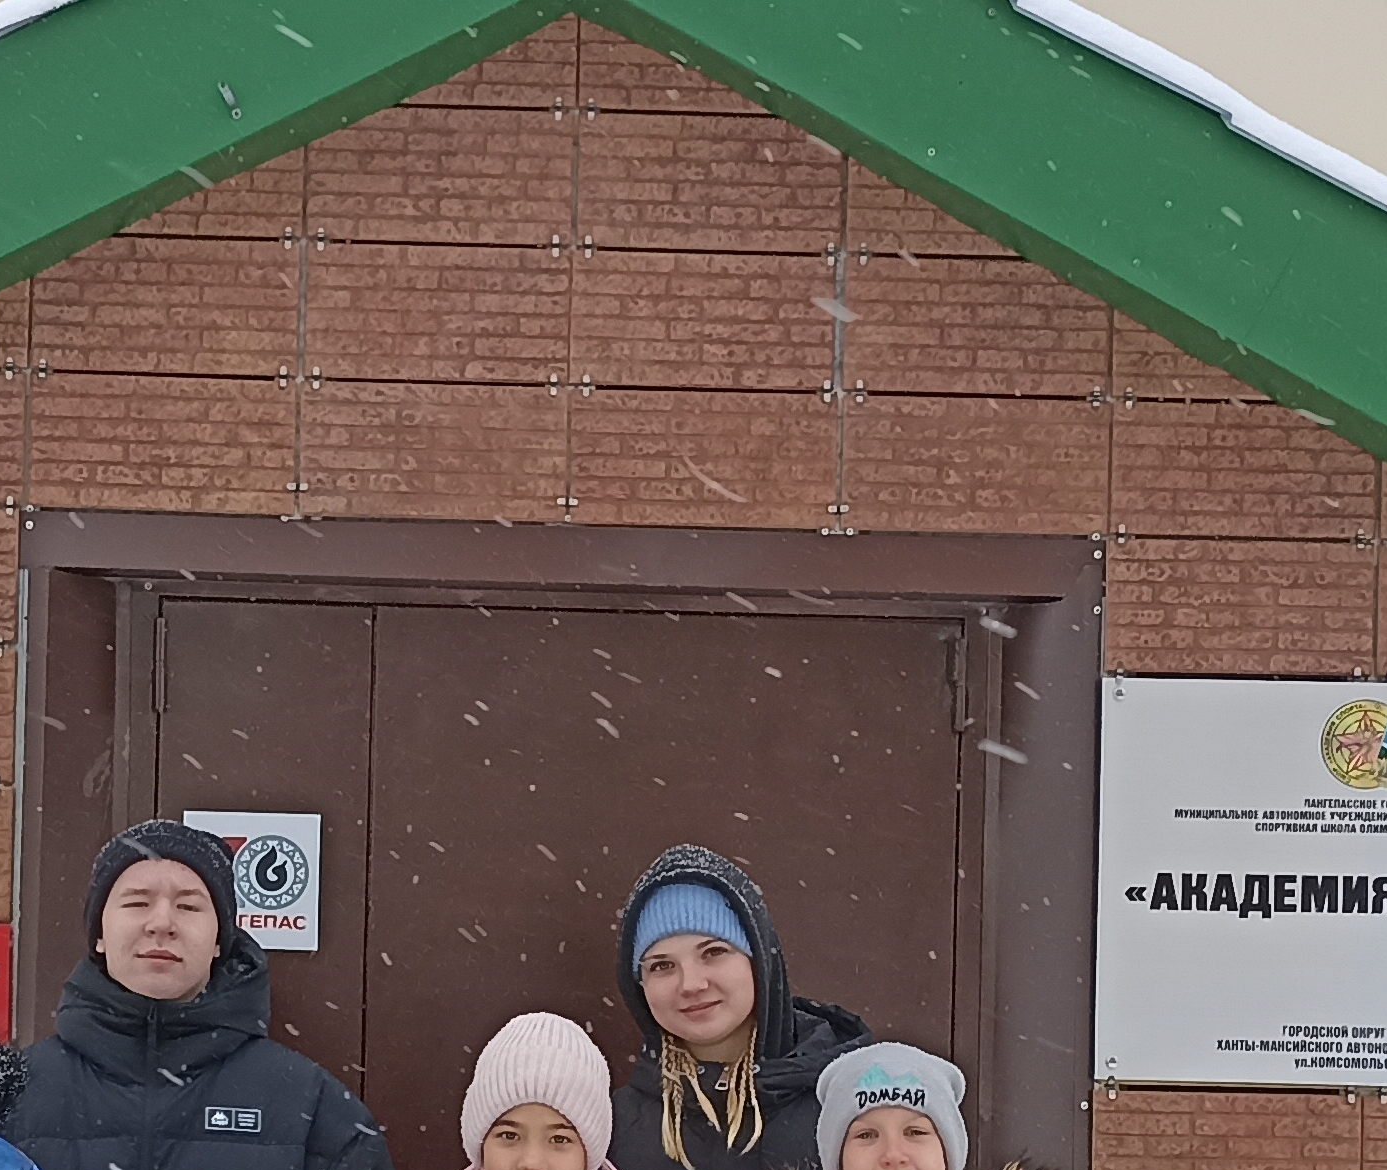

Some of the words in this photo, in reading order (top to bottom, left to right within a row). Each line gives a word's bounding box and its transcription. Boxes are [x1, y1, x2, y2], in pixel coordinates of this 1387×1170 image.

[1174, 809, 1259, 820] МУНИЦИПАЛЬНОЕ
[1262, 810, 1326, 821] АВТОНОМНОЕ
[1254, 822, 1318, 833] СПОРТИВНАЯ
[1320, 824, 1357, 834] ШКОЛА
[238, 914, 307, 930] ГЕПАС
[1282, 1025, 1349, 1039] ГОРОДСКОЙ
[1351, 1026, 1387, 1039] ОКРУГ
[1216, 1039, 1343, 1053] ХАНТЫ-МАНСИЙСКОГО
[855, 1087, 926, 1109] ДОМБАЙ
